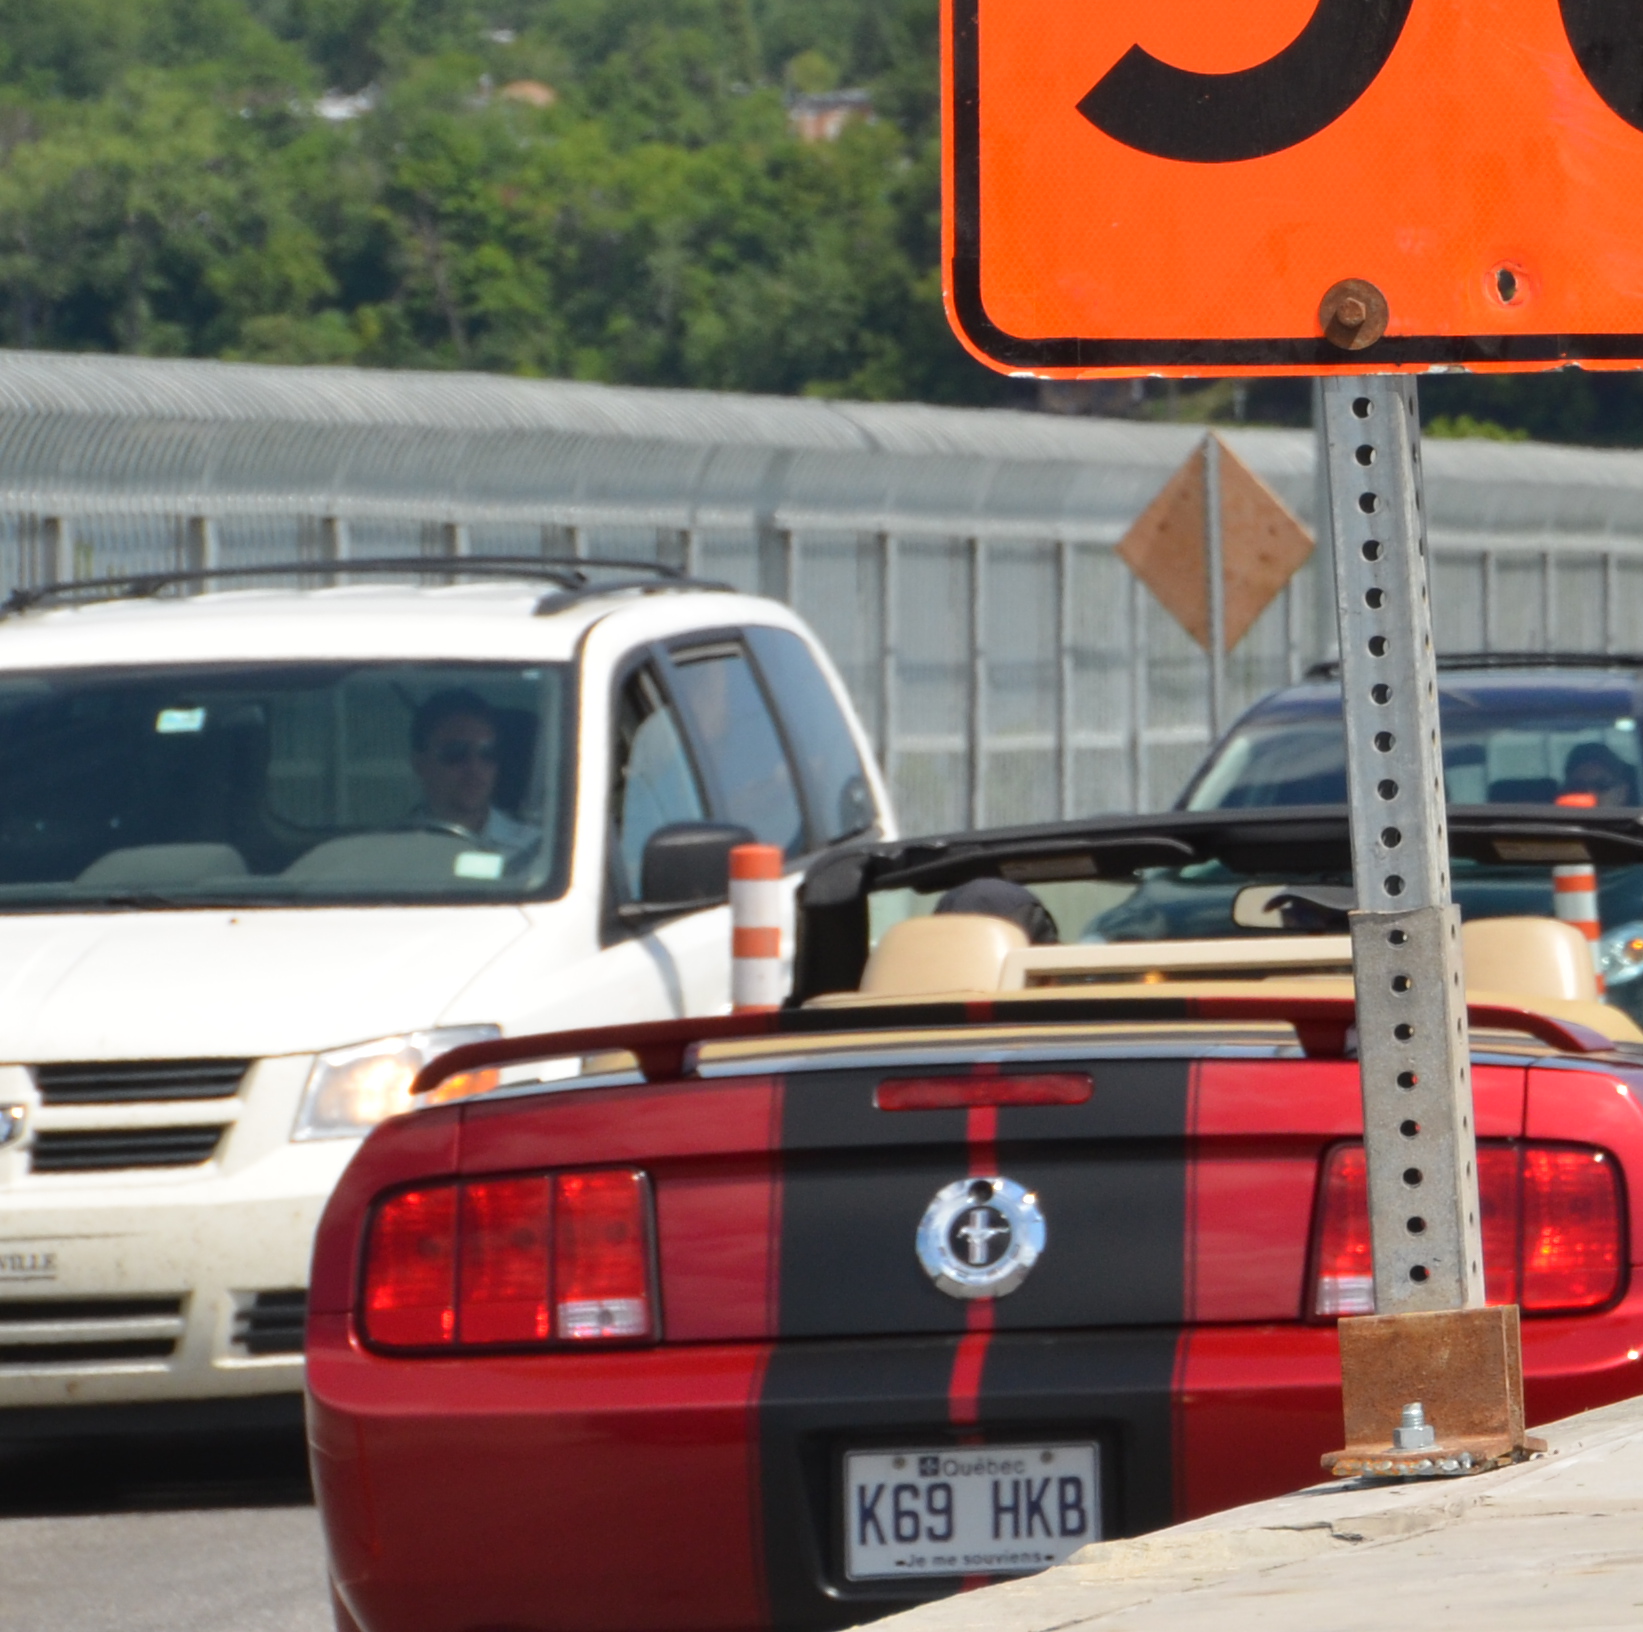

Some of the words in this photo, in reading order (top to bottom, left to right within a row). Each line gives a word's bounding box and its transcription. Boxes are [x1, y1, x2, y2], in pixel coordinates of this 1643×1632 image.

[943, 1457, 1026, 1477] Québec
[858, 1481, 953, 1545] K69
[991, 1476, 1088, 1539] HKB
[906, 1554, 926, 1568] Je
[932, 1555, 957, 1567] me
[963, 1550, 1042, 1566] souviens
